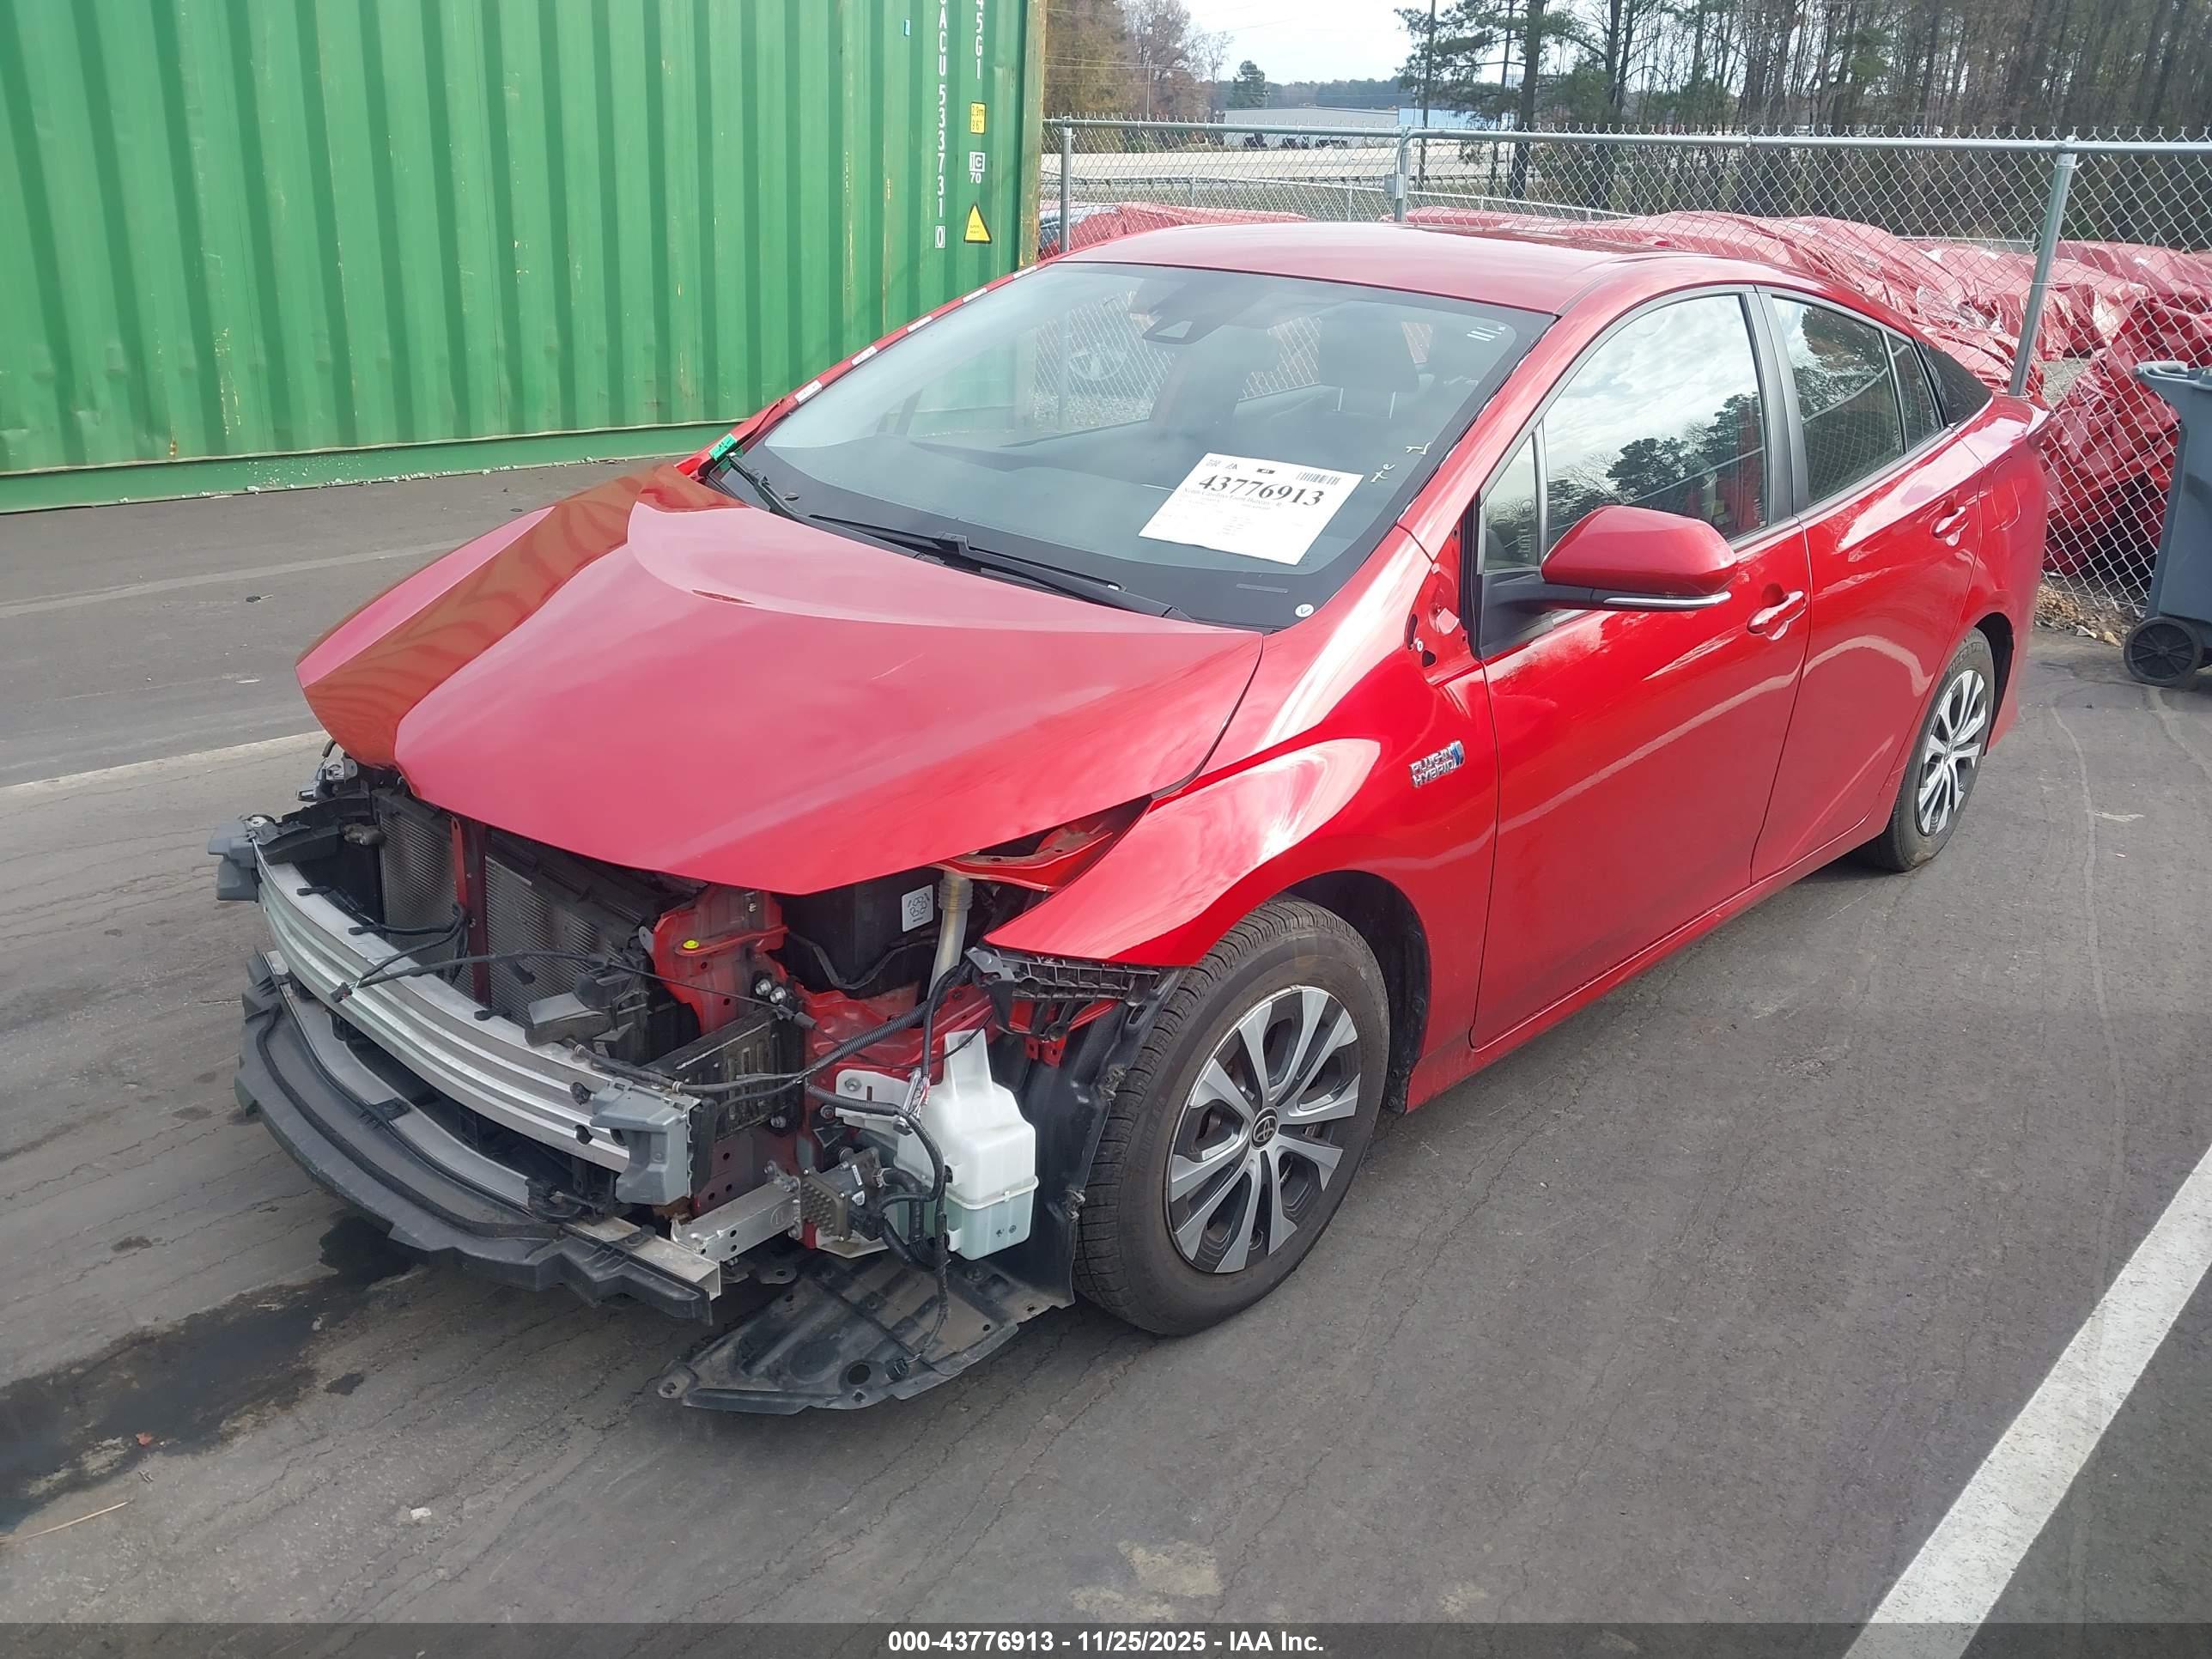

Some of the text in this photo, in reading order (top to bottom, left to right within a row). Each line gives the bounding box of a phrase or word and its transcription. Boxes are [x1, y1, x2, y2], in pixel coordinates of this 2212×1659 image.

[938, 0, 947, 76] ACU
[938, 84, 946, 218] 533731
[969, 172, 982, 184] 70
[1198, 474, 1325, 507] 43776913
